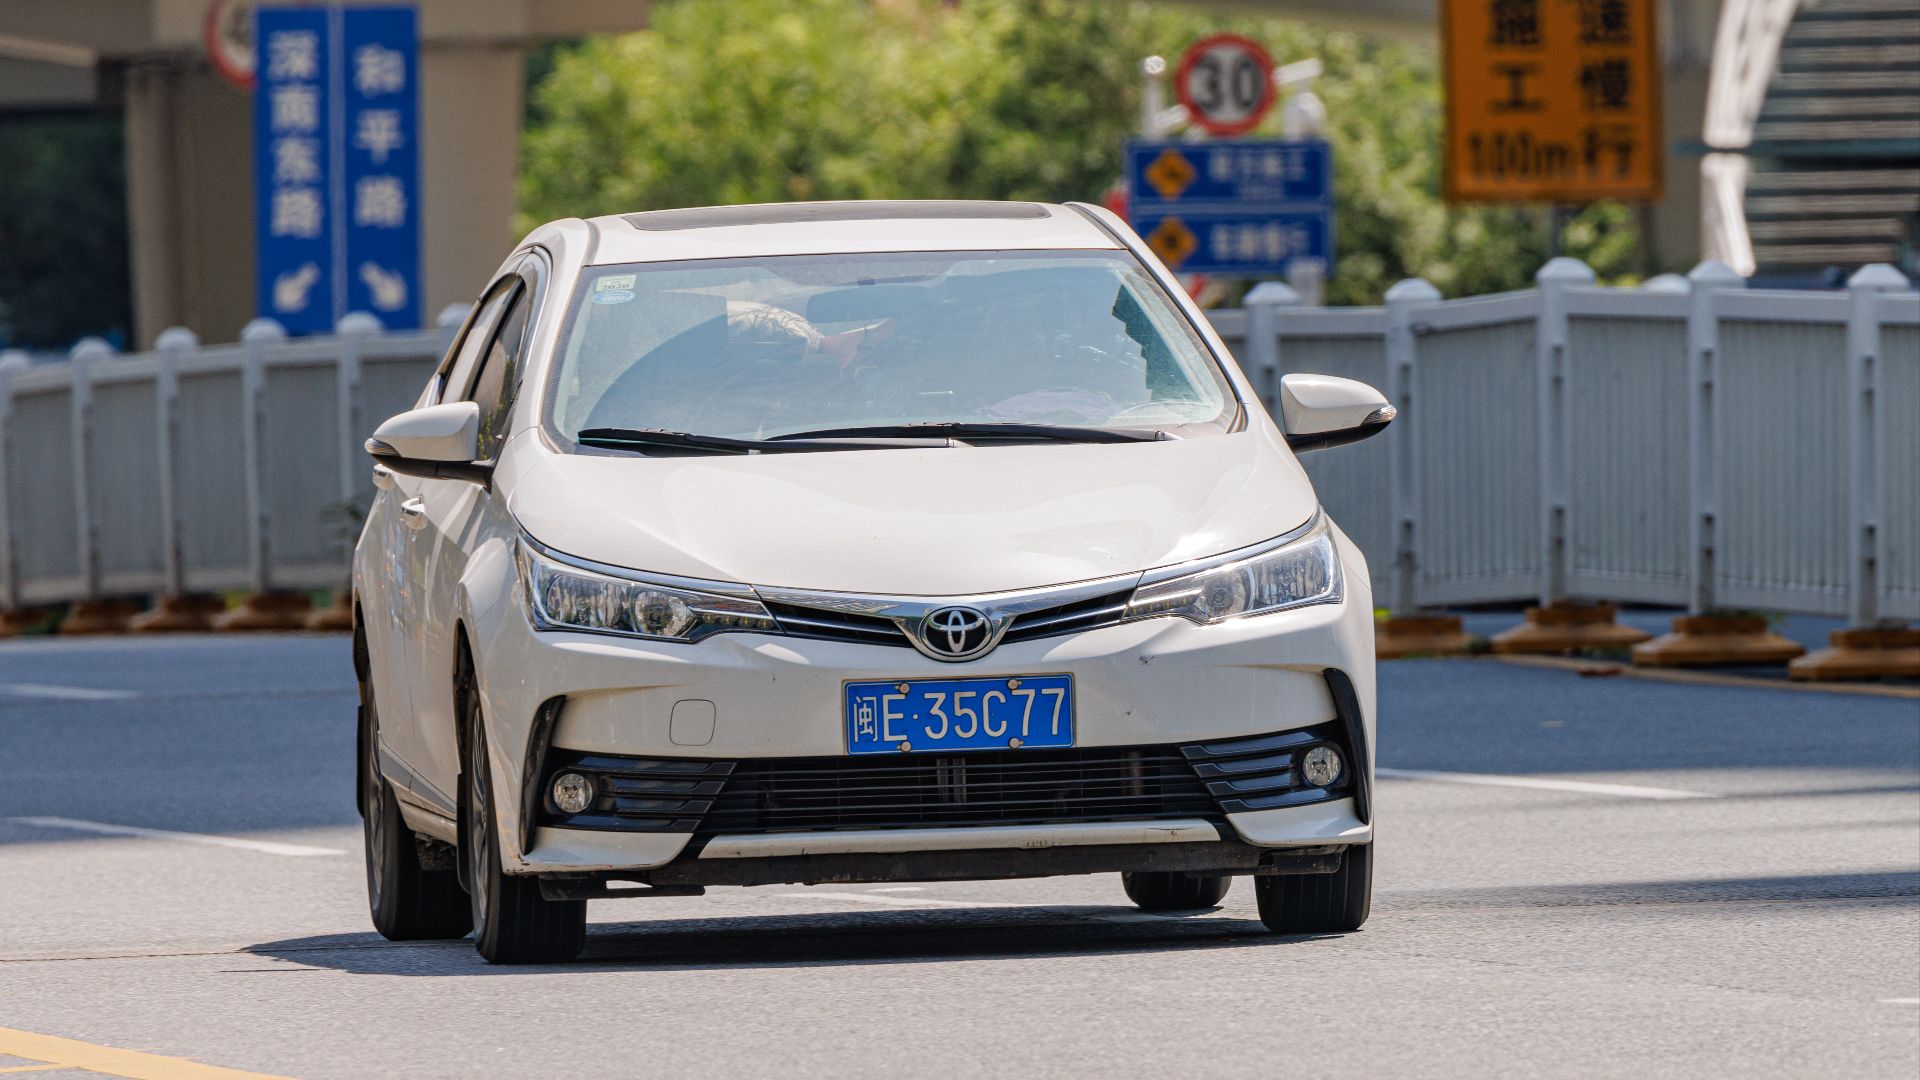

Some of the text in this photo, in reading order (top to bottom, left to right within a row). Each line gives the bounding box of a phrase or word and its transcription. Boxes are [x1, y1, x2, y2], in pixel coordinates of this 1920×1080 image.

[267, 29, 324, 239] 深南东路
[354, 43, 408, 229] 和平路
[1195, 55, 1264, 112] 30
[1468, 130, 1572, 177] 100m
